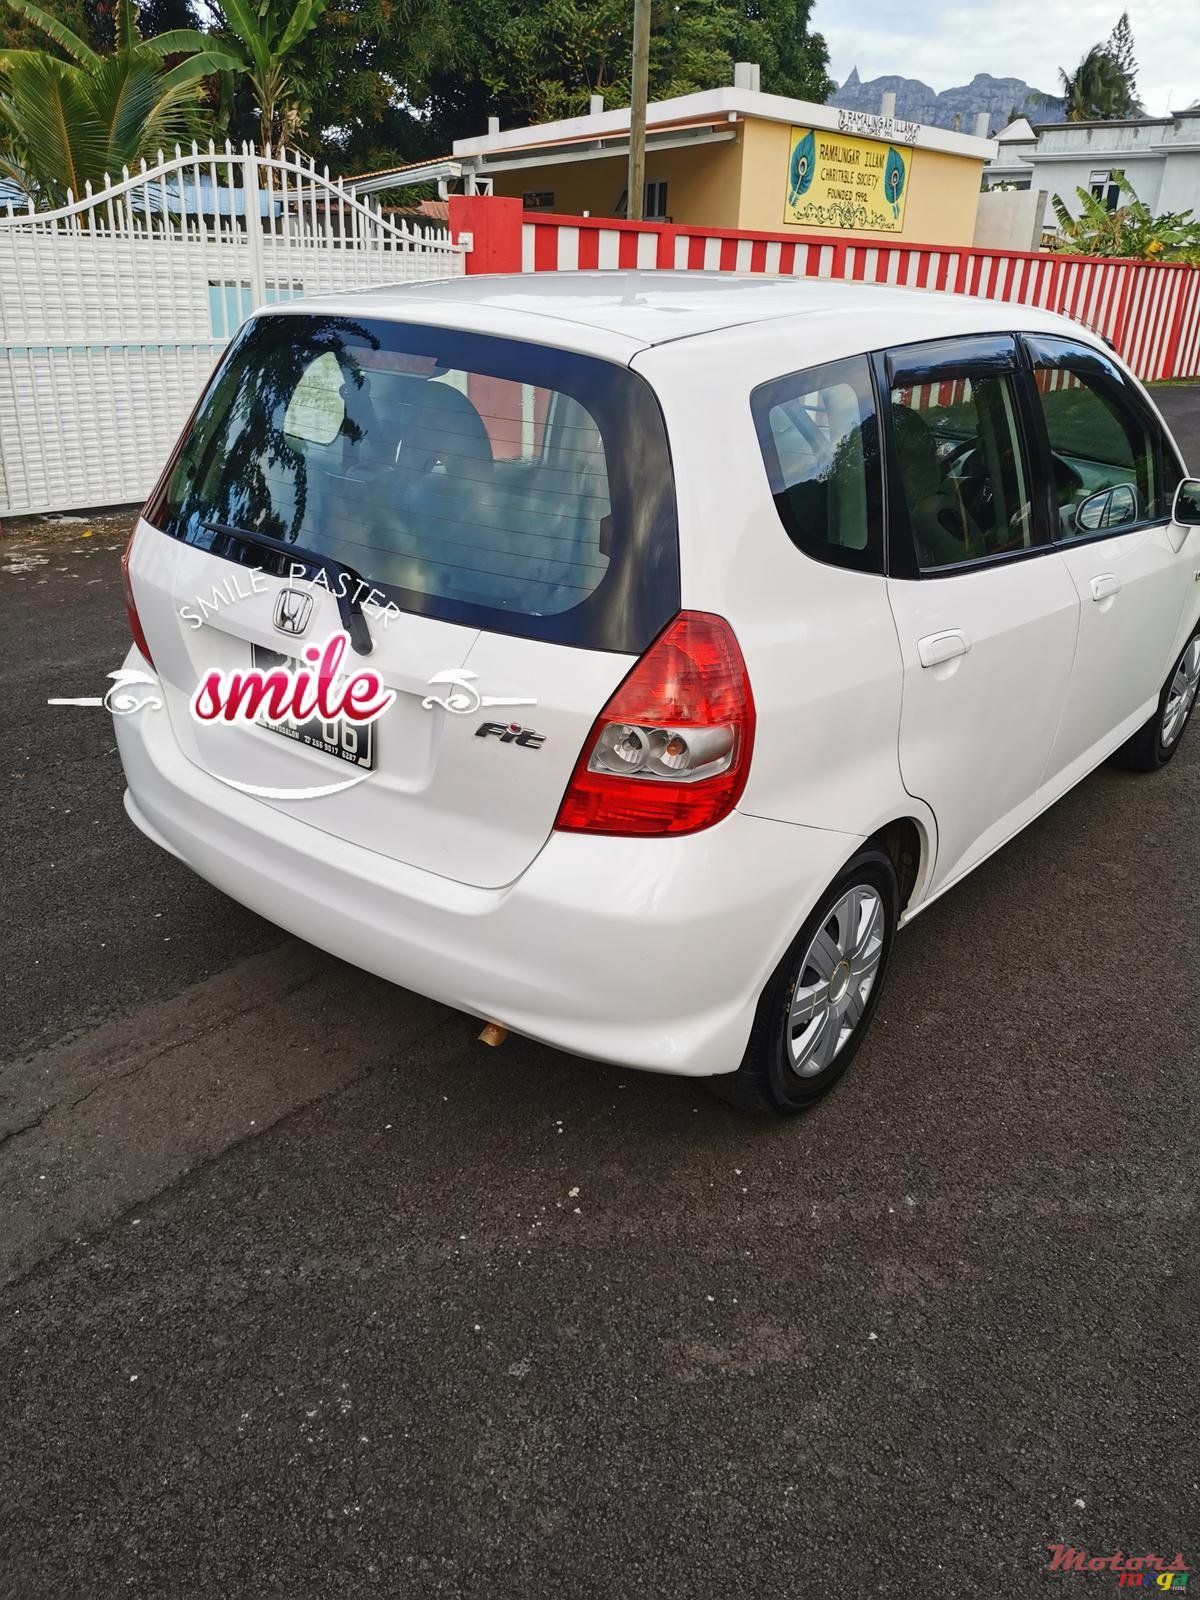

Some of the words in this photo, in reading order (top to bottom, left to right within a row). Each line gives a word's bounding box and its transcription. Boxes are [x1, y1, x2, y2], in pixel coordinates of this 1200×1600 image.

[848, 111, 892, 130] RAMALINGAR
[819, 144, 860, 165] RAMALINGAR
[864, 151, 885, 168] ILLAM
[820, 167, 854, 185] CHARITABLE
[856, 171, 880, 190] SOCIETY
[826, 187, 853, 201] FOUNDED
[855, 190, 869, 202] 1992
